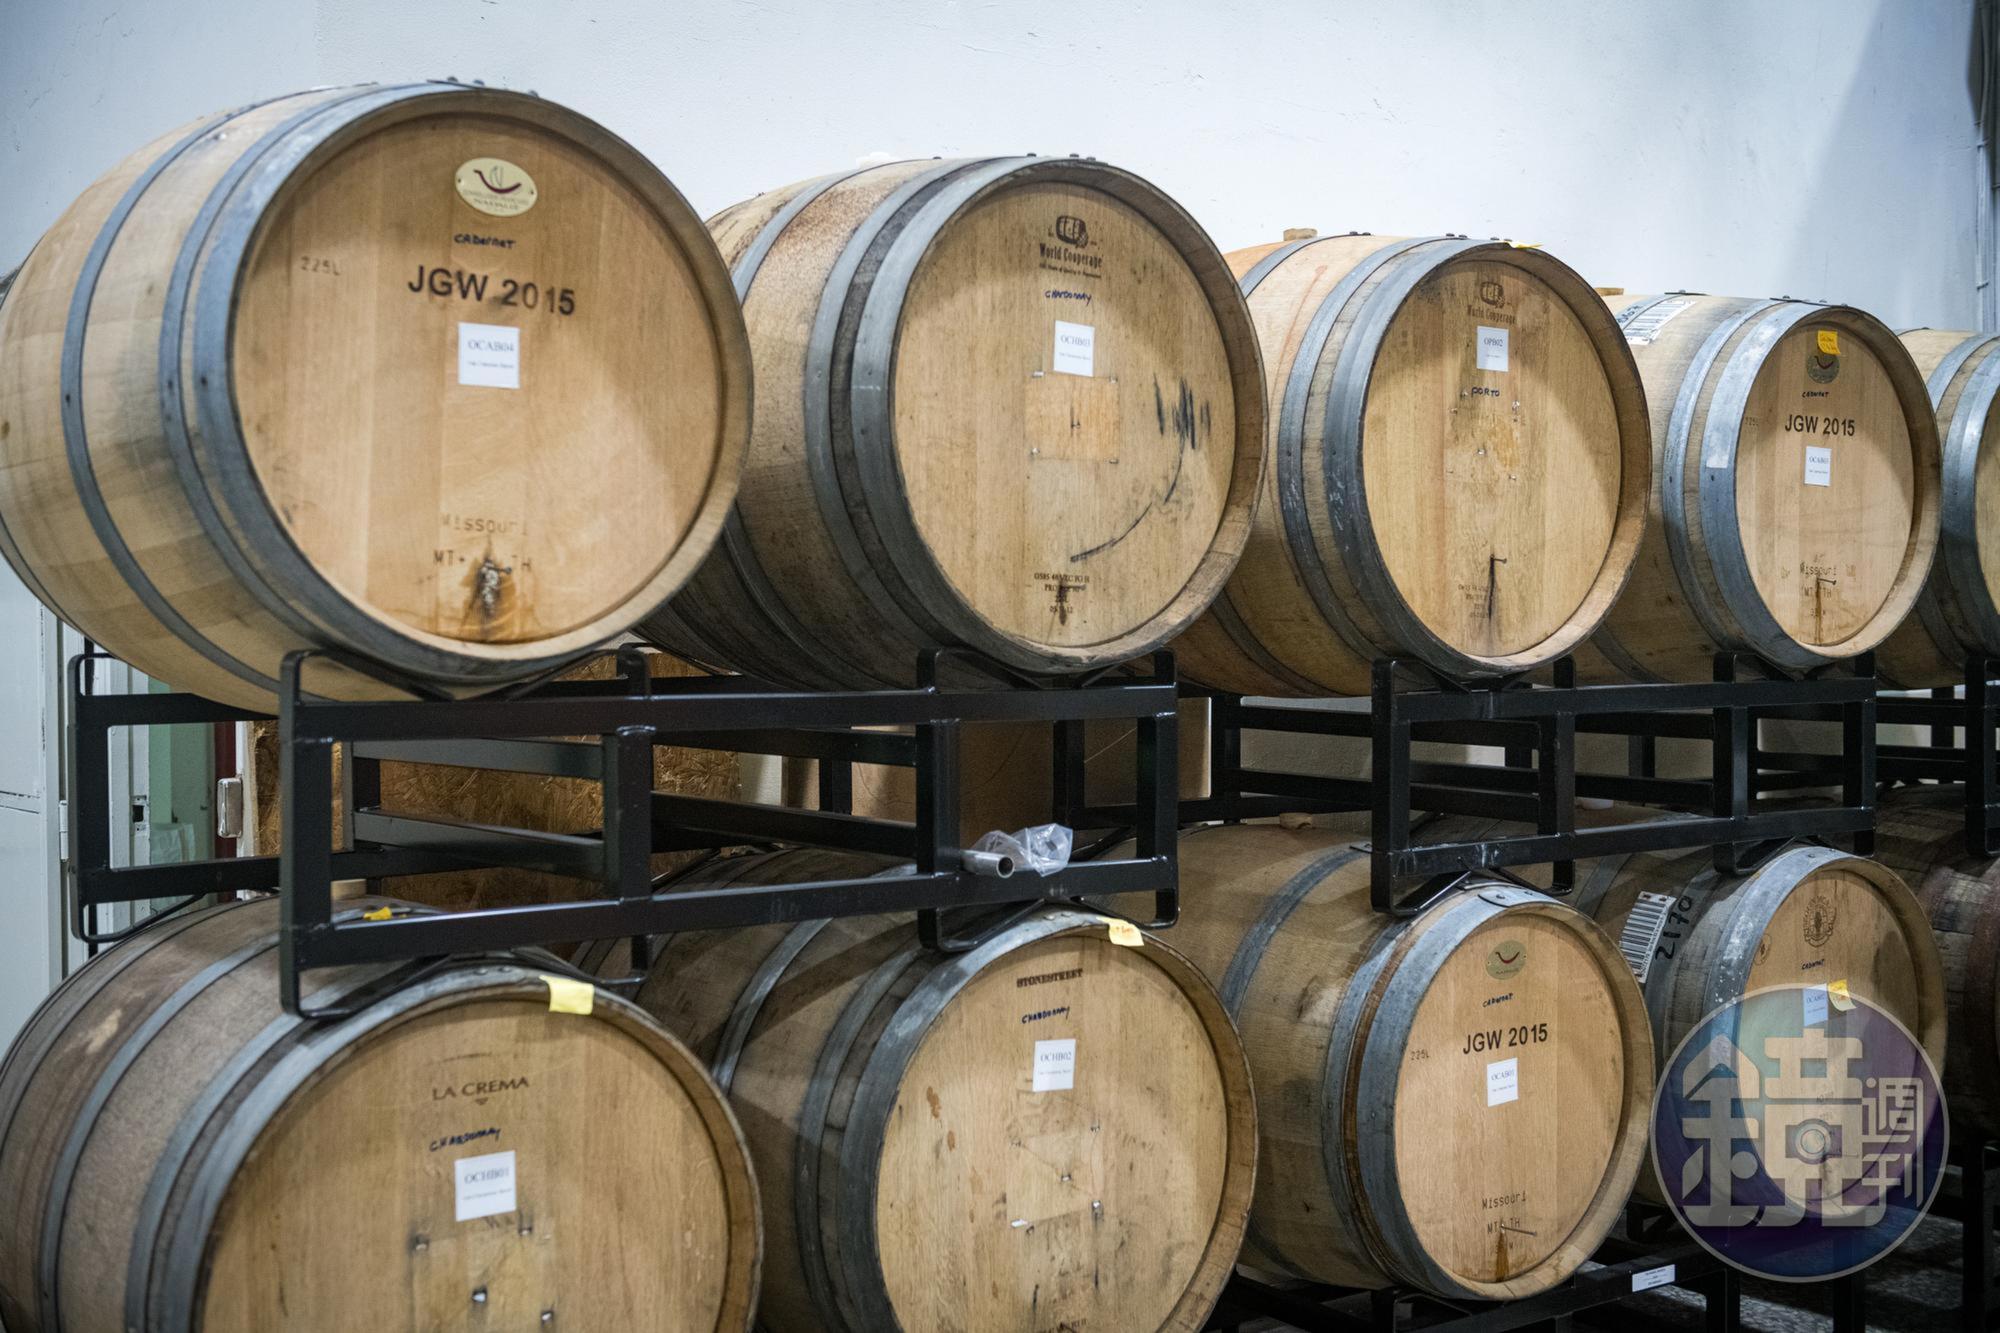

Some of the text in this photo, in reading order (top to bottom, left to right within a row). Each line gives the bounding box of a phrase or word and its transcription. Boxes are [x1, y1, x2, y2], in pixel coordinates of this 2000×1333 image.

[1063, 247, 1102, 269] Cooperage
[407, 264, 576, 316] JGW 2015
[1471, 386, 1500, 398] PORTO
[1784, 414, 1856, 437] JGW 2015
[1016, 968, 1084, 989] STONESTREET
[1462, 1023, 1549, 1055] JGW 2015
[432, 1076, 530, 1101] LA CREMA
